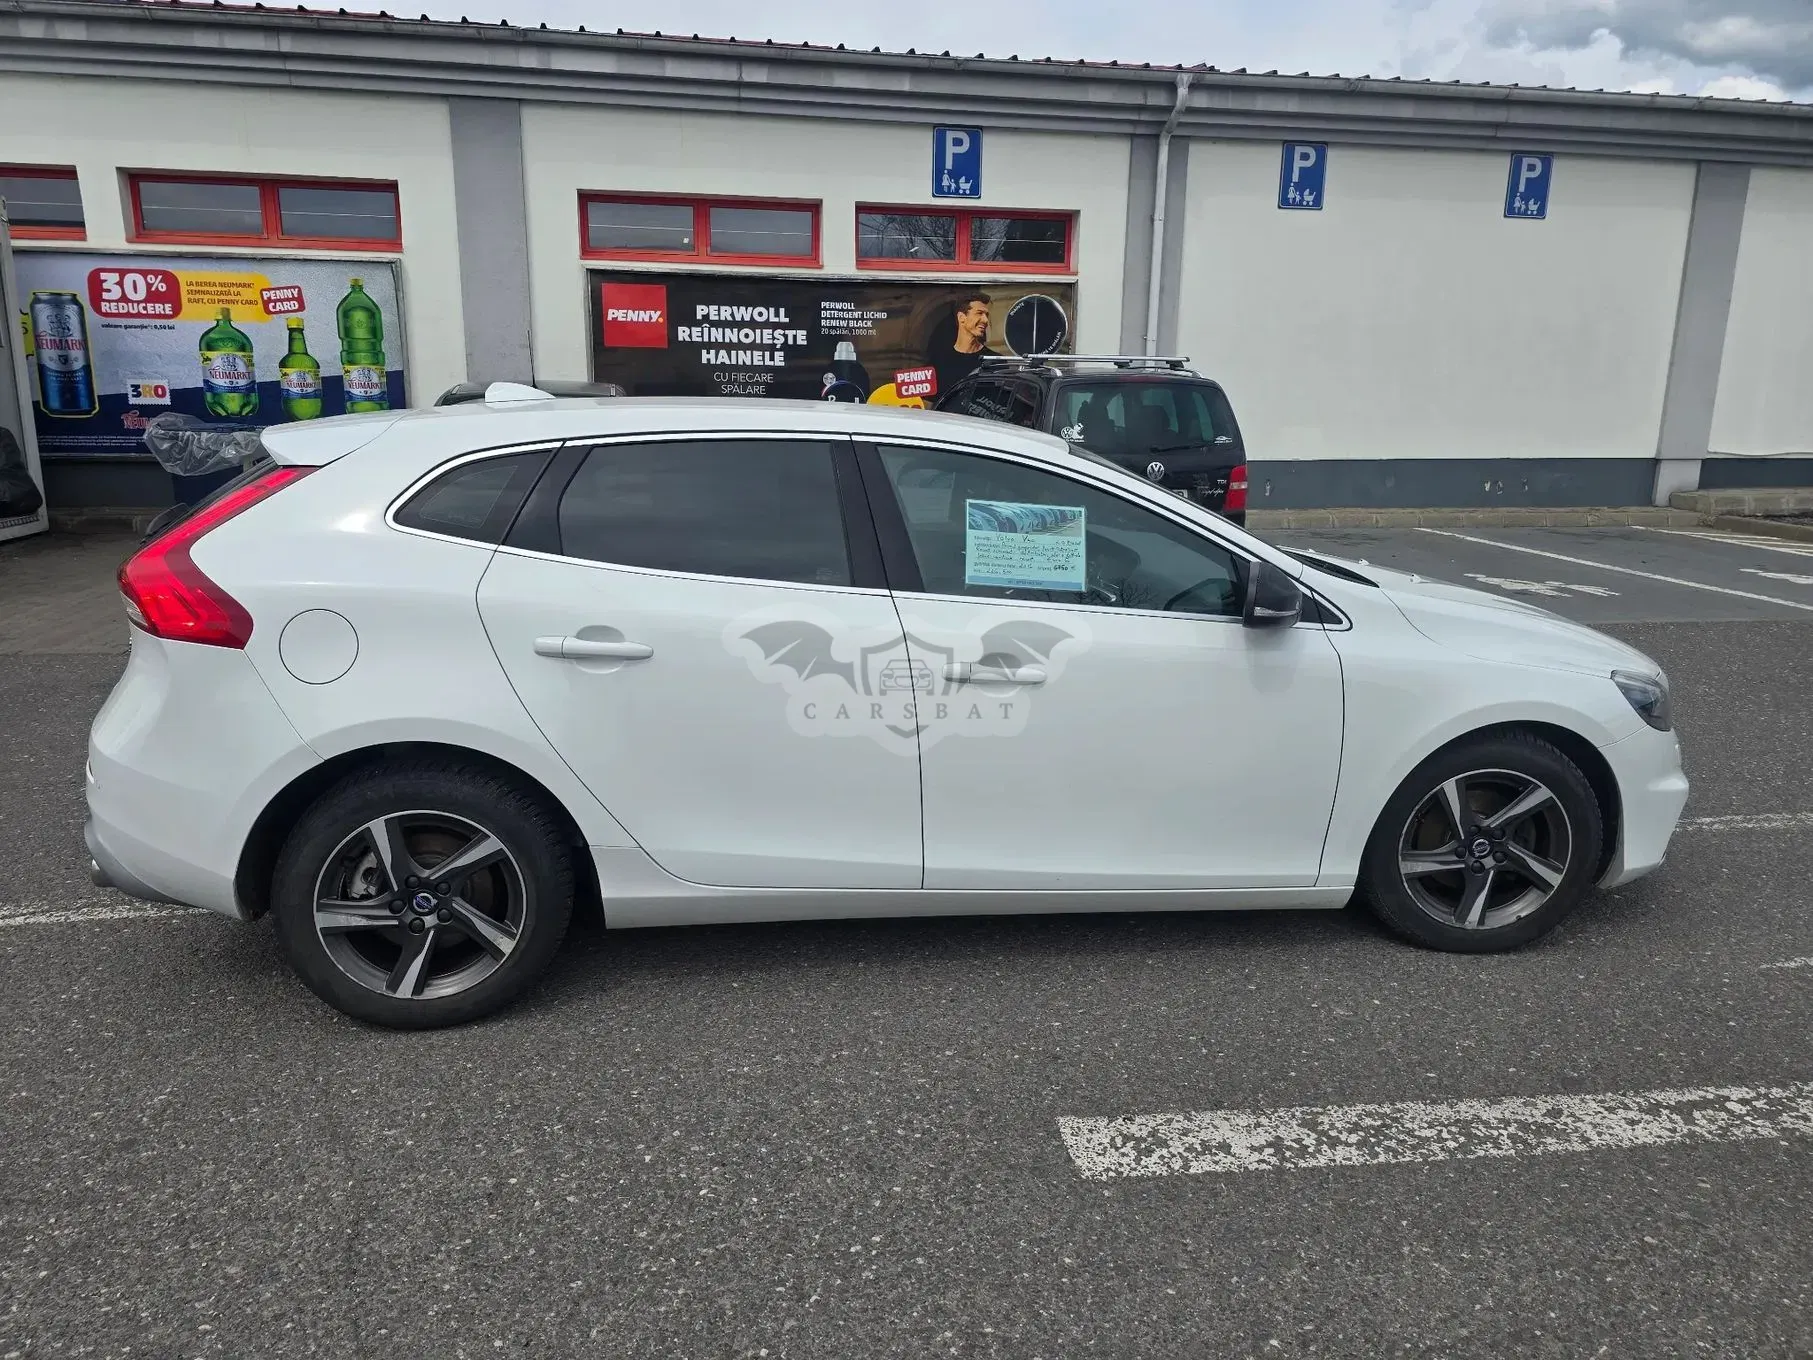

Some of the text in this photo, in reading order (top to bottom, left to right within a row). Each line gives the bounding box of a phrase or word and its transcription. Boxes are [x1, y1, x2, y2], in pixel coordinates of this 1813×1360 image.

[946, 131, 970, 169] P
[1293, 146, 1316, 182] P
[1519, 158, 1542, 192] P
[100, 272, 167, 301] 30%
[262, 288, 299, 300] PENNY
[101, 302, 173, 315] REDUCERE
[268, 301, 298, 313] CARD
[821, 301, 855, 310] PERWOLL
[696, 305, 790, 323] PERWOLL
[821, 310, 887, 319] DETERGENT LICHID
[821, 319, 873, 328] RENEW BLACK
[677, 323, 808, 349] REÎNNOIEȘTE
[701, 349, 785, 366] HAINELE
[714, 372, 774, 383] CU FIECARE
[896, 370, 933, 383] PENNY
[130, 384, 167, 399] 3RO
[721, 382, 766, 395] SPĂLARE
[901, 383, 931, 395] CARD
